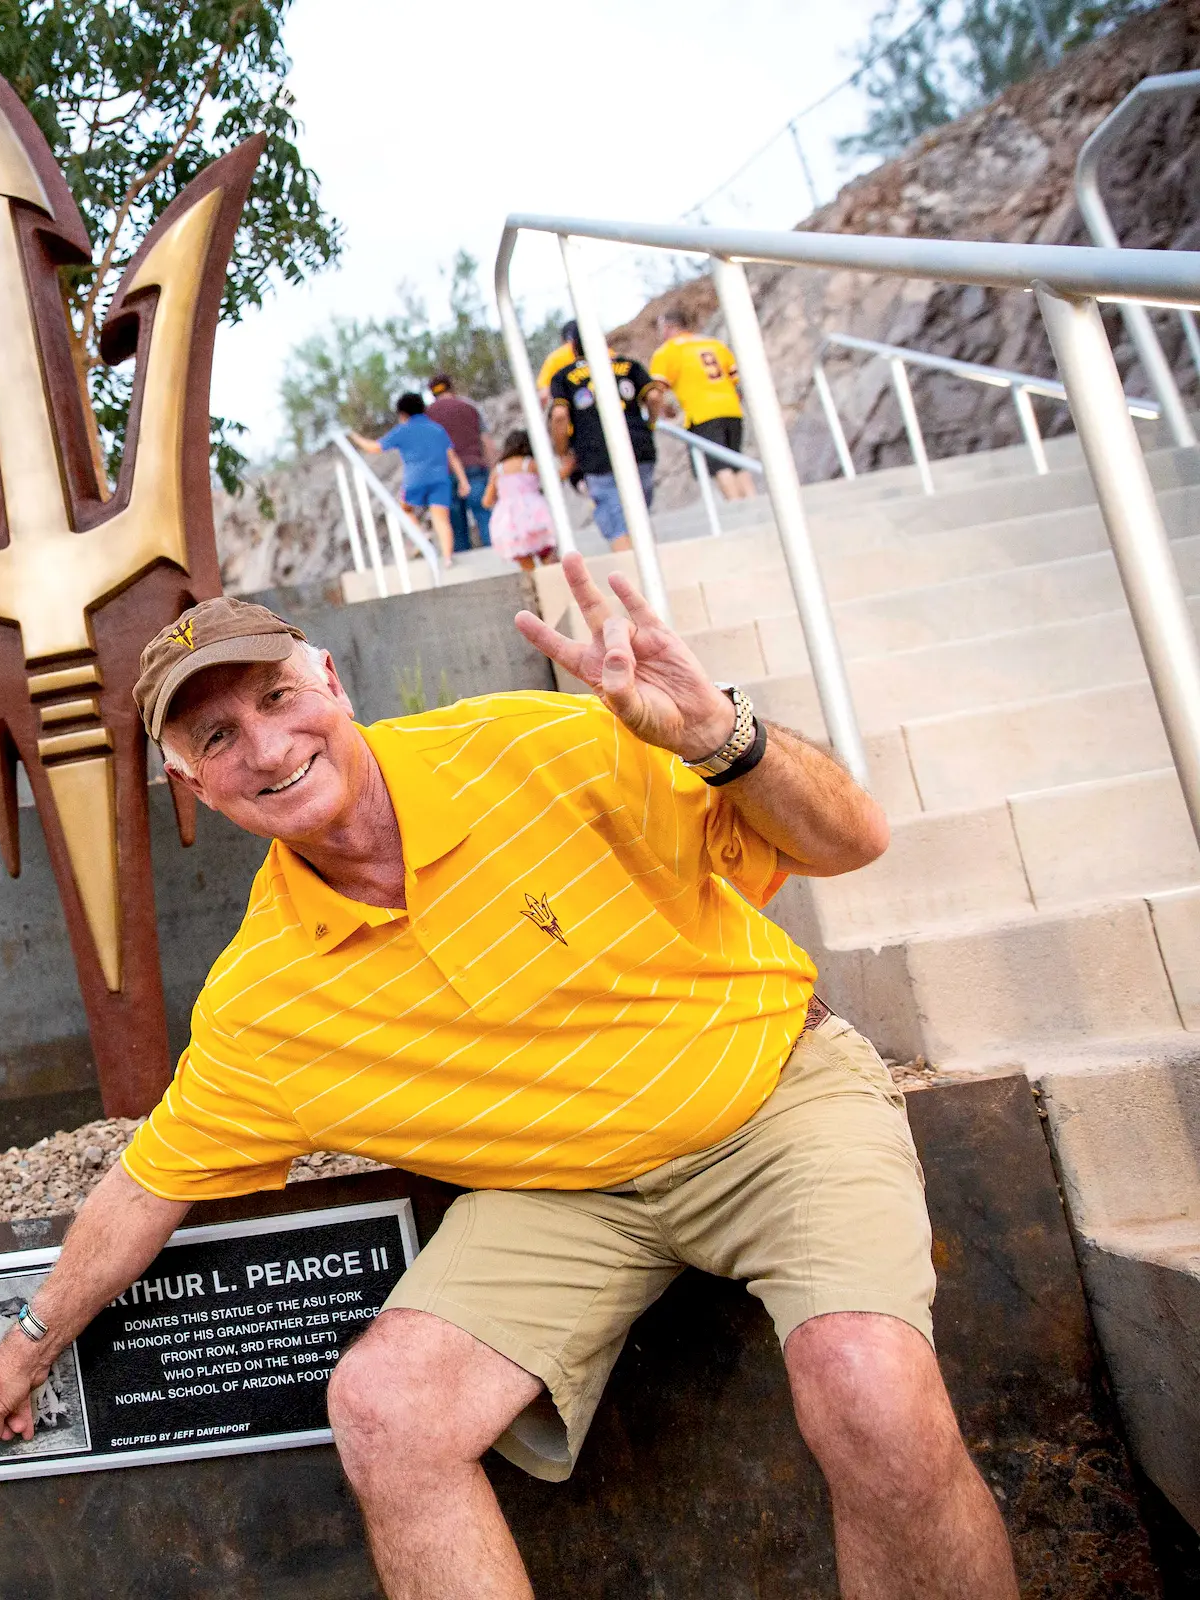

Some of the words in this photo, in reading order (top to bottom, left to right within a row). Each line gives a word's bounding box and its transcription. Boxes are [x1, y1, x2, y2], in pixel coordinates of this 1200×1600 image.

[212, 1270, 238, 1294] L.
[245, 1250, 364, 1289] PEARCE
[370, 1246, 389, 1272] II
[113, 1340, 125, 1351] IN
[127, 1334, 172, 1350] HONOR
[174, 1331, 191, 1344] OF
[193, 1328, 215, 1341] HIS
[216, 1316, 304, 1338] GRANDFATHER
[305, 1313, 330, 1326] ZEB
[331, 1306, 380, 1322] PEARCE
[124, 1315, 180, 1332] DONATES
[180, 1311, 209, 1325] THIS
[210, 1305, 255, 1321] STATUE
[256, 1302, 274, 1315] OF
[275, 1299, 301, 1312] THE
[302, 1295, 327, 1309] ASU
[329, 1290, 363, 1305] FORK
[160, 1348, 204, 1365] (FRONT
[205, 1344, 239, 1358] ROW,
[240, 1340, 265, 1353] 3RD
[266, 1335, 302, 1350] FROM
[304, 1330, 337, 1345] LEFT)
[115, 1390, 166, 1405] NORMAL
[167, 1383, 220, 1399] SCHOOL
[222, 1380, 239, 1392] OF
[242, 1373, 295, 1390] ARIZONA
[296, 1368, 335, 1383] FOOT
[163, 1367, 195, 1381] WHO
[196, 1361, 242, 1377] PLAYED
[244, 1358, 263, 1371] ON
[264, 1355, 290, 1368] THE
[110, 1434, 157, 1447] SCULPTED
[159, 1432, 171, 1441] BY
[172, 1429, 195, 1440] JEFF
[196, 1422, 251, 1437] DAVENPORT
